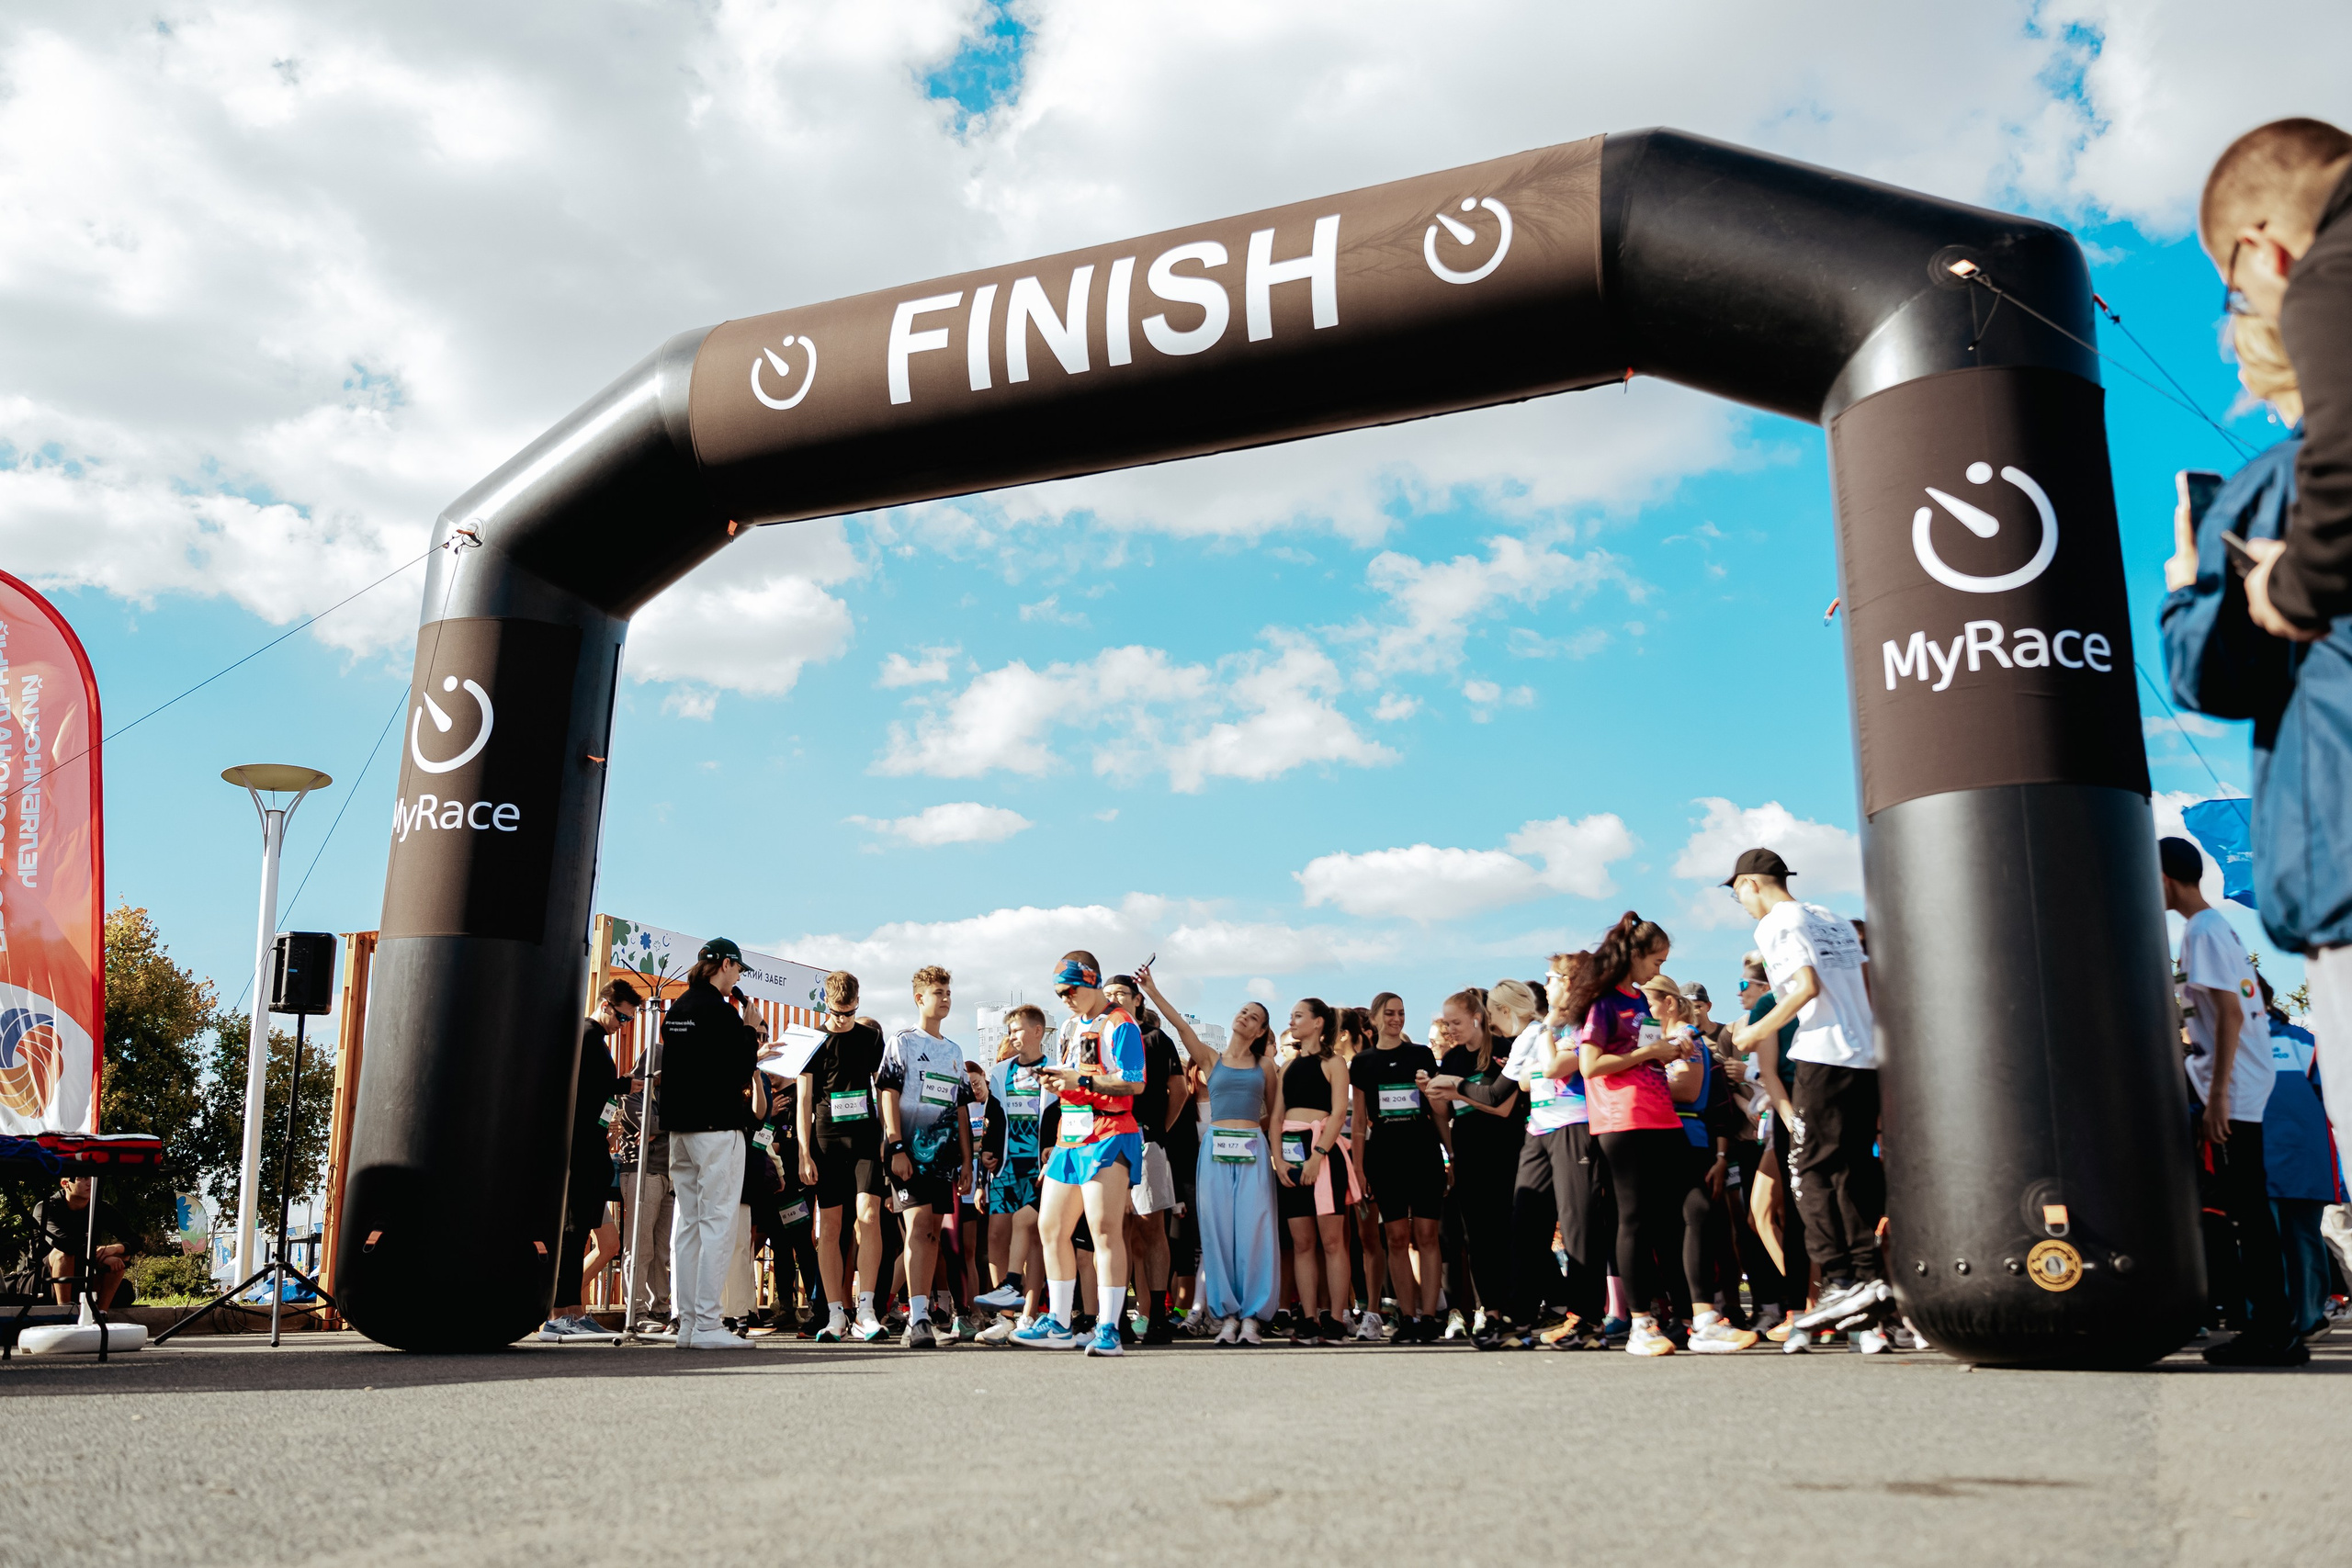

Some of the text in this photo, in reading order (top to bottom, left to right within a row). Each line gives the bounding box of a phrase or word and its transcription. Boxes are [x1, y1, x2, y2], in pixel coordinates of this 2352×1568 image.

[888, 213, 1340, 405] FINISH
[1882, 619, 2112, 692] MyRace
[764, 973, 787, 987] ЗАБЕГ
